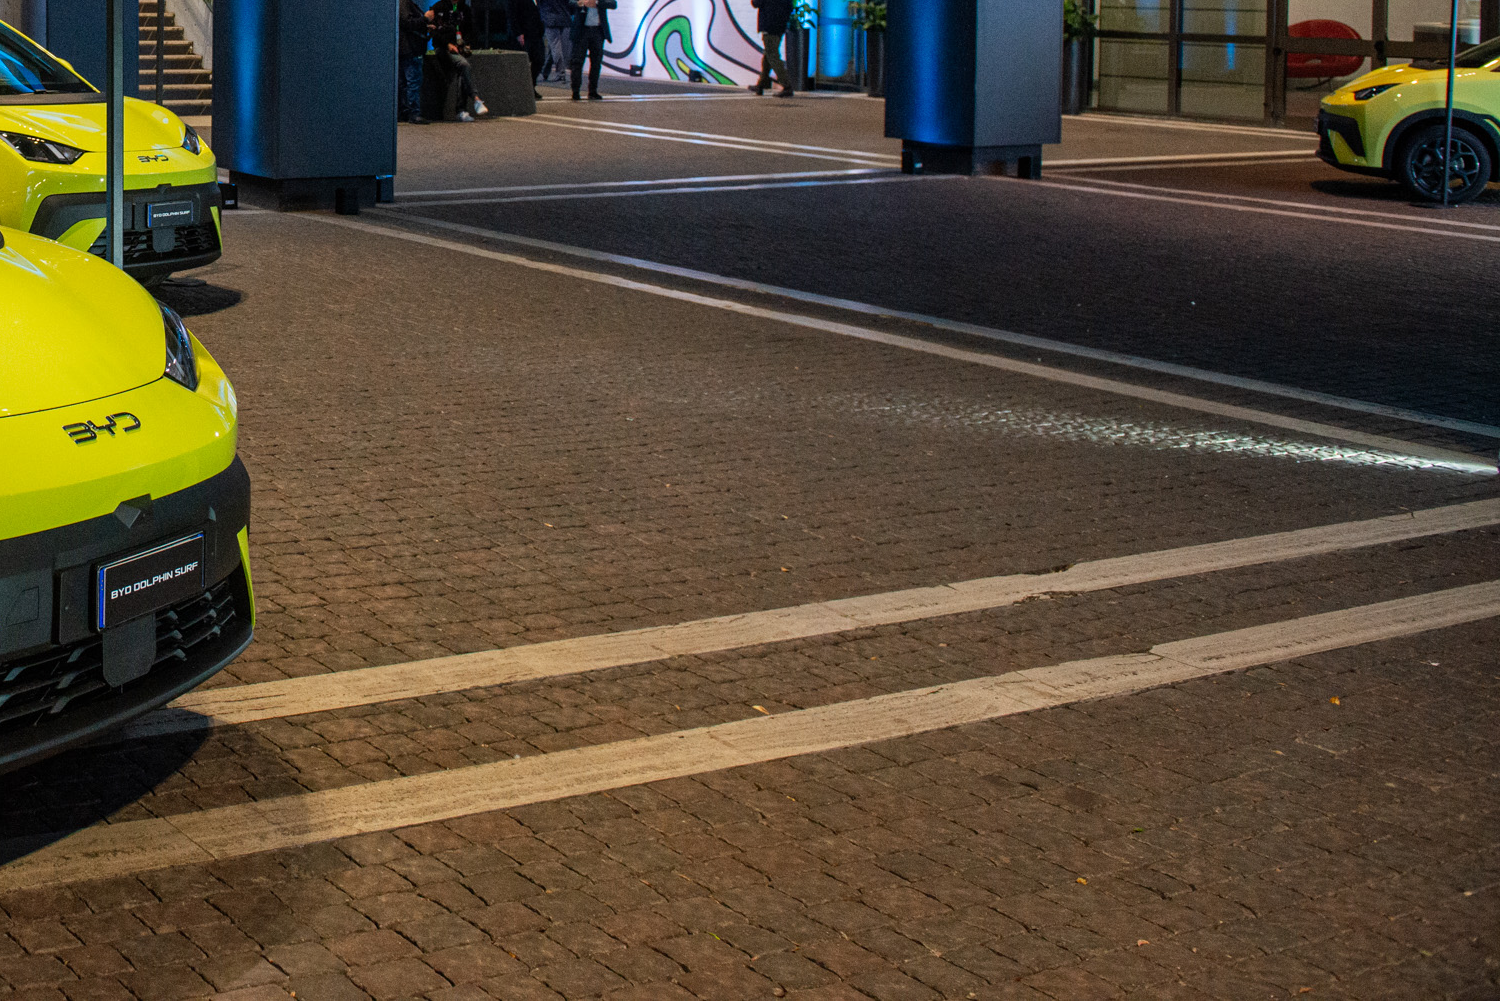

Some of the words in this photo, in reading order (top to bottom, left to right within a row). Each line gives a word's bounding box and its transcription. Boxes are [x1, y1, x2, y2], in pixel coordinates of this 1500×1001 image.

[137, 154, 169, 163] BYD
[62, 411, 141, 445] BYD
[111, 585, 132, 599] BYD
[133, 570, 173, 592] DOLPHIN
[174, 561, 198, 577] SURF
